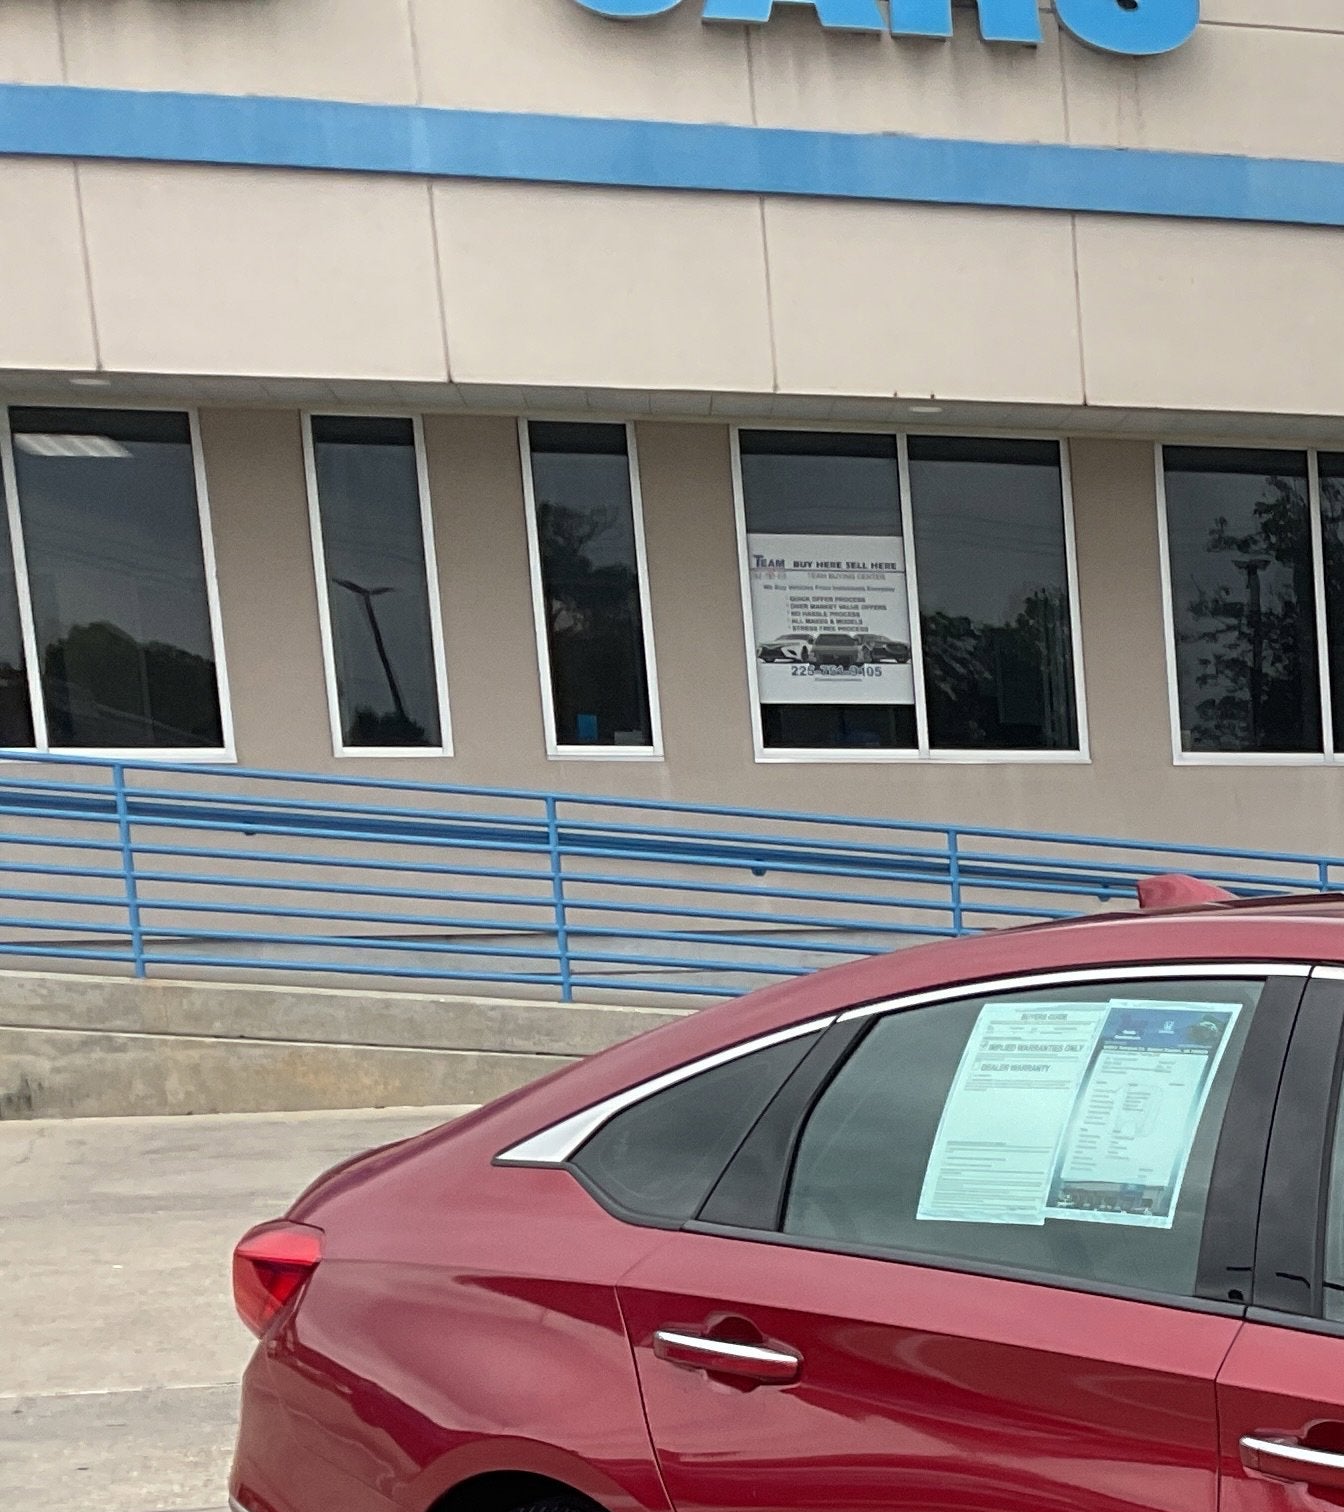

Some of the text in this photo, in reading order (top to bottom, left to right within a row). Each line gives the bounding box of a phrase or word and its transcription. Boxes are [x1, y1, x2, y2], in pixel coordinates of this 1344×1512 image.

[793, 560, 897, 570] BUY HERE SELL HERE
